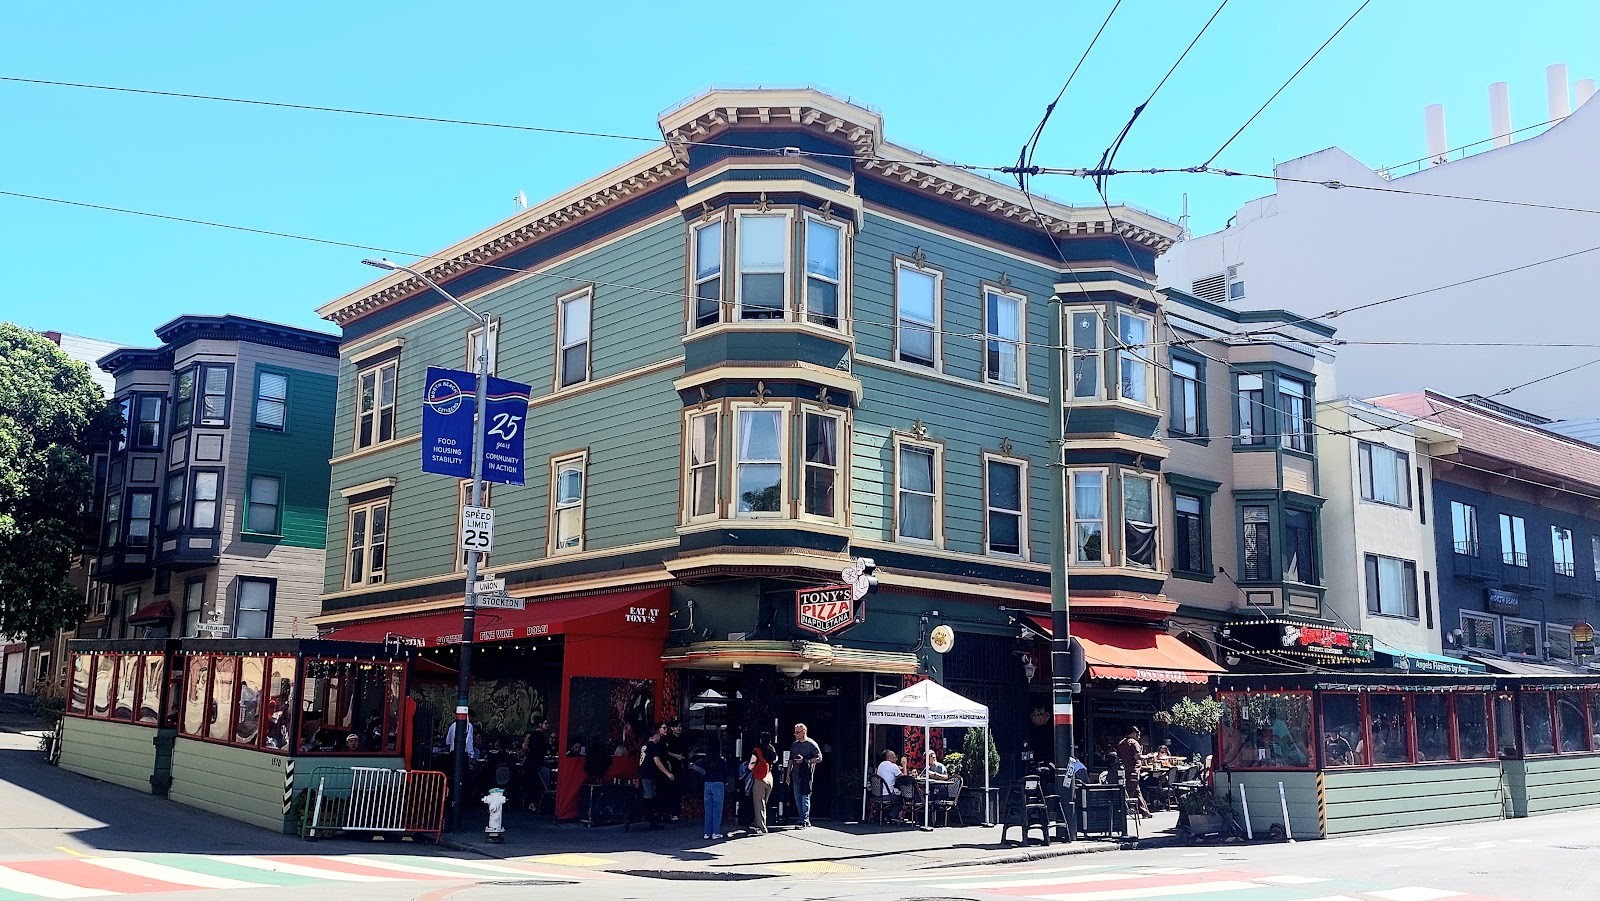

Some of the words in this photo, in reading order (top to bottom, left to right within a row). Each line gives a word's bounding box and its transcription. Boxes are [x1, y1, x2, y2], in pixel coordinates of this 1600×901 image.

[430, 382, 443, 399] NORTH
[442, 381, 458, 394] BEACH
[437, 402, 459, 413] CITIZENS
[487, 412, 523, 441] 25
[437, 437, 457, 446] FOOD
[433, 446, 462, 456] HOUSING
[431, 455, 463, 465] STABILITY
[485, 453, 519, 464] COMMUNITY
[496, 464, 517, 473] ACTION
[465, 510, 492, 521] SPEED
[467, 519, 489, 529] LIMIT
[464, 529, 490, 547] 25
[479, 582, 498, 591] UNION
[482, 596, 520, 608] STOCKTON
[800, 589, 852, 604] TONY'S
[630, 607, 646, 615] EAT
[802, 601, 849, 621] PIZZA
[625, 614, 655, 623] TONY'S
[802, 612, 849, 630] NAPOLETANA
[480, 631, 495, 640] FINE
[496, 629, 513, 639] WINE
[527, 625, 548, 635] DOLCI
[1415, 660, 1433, 670] Angels
[1432, 661, 1451, 672] Flowers
[1451, 664, 1458, 674] by
[896, 712, 926, 720] NAPOLETANA
